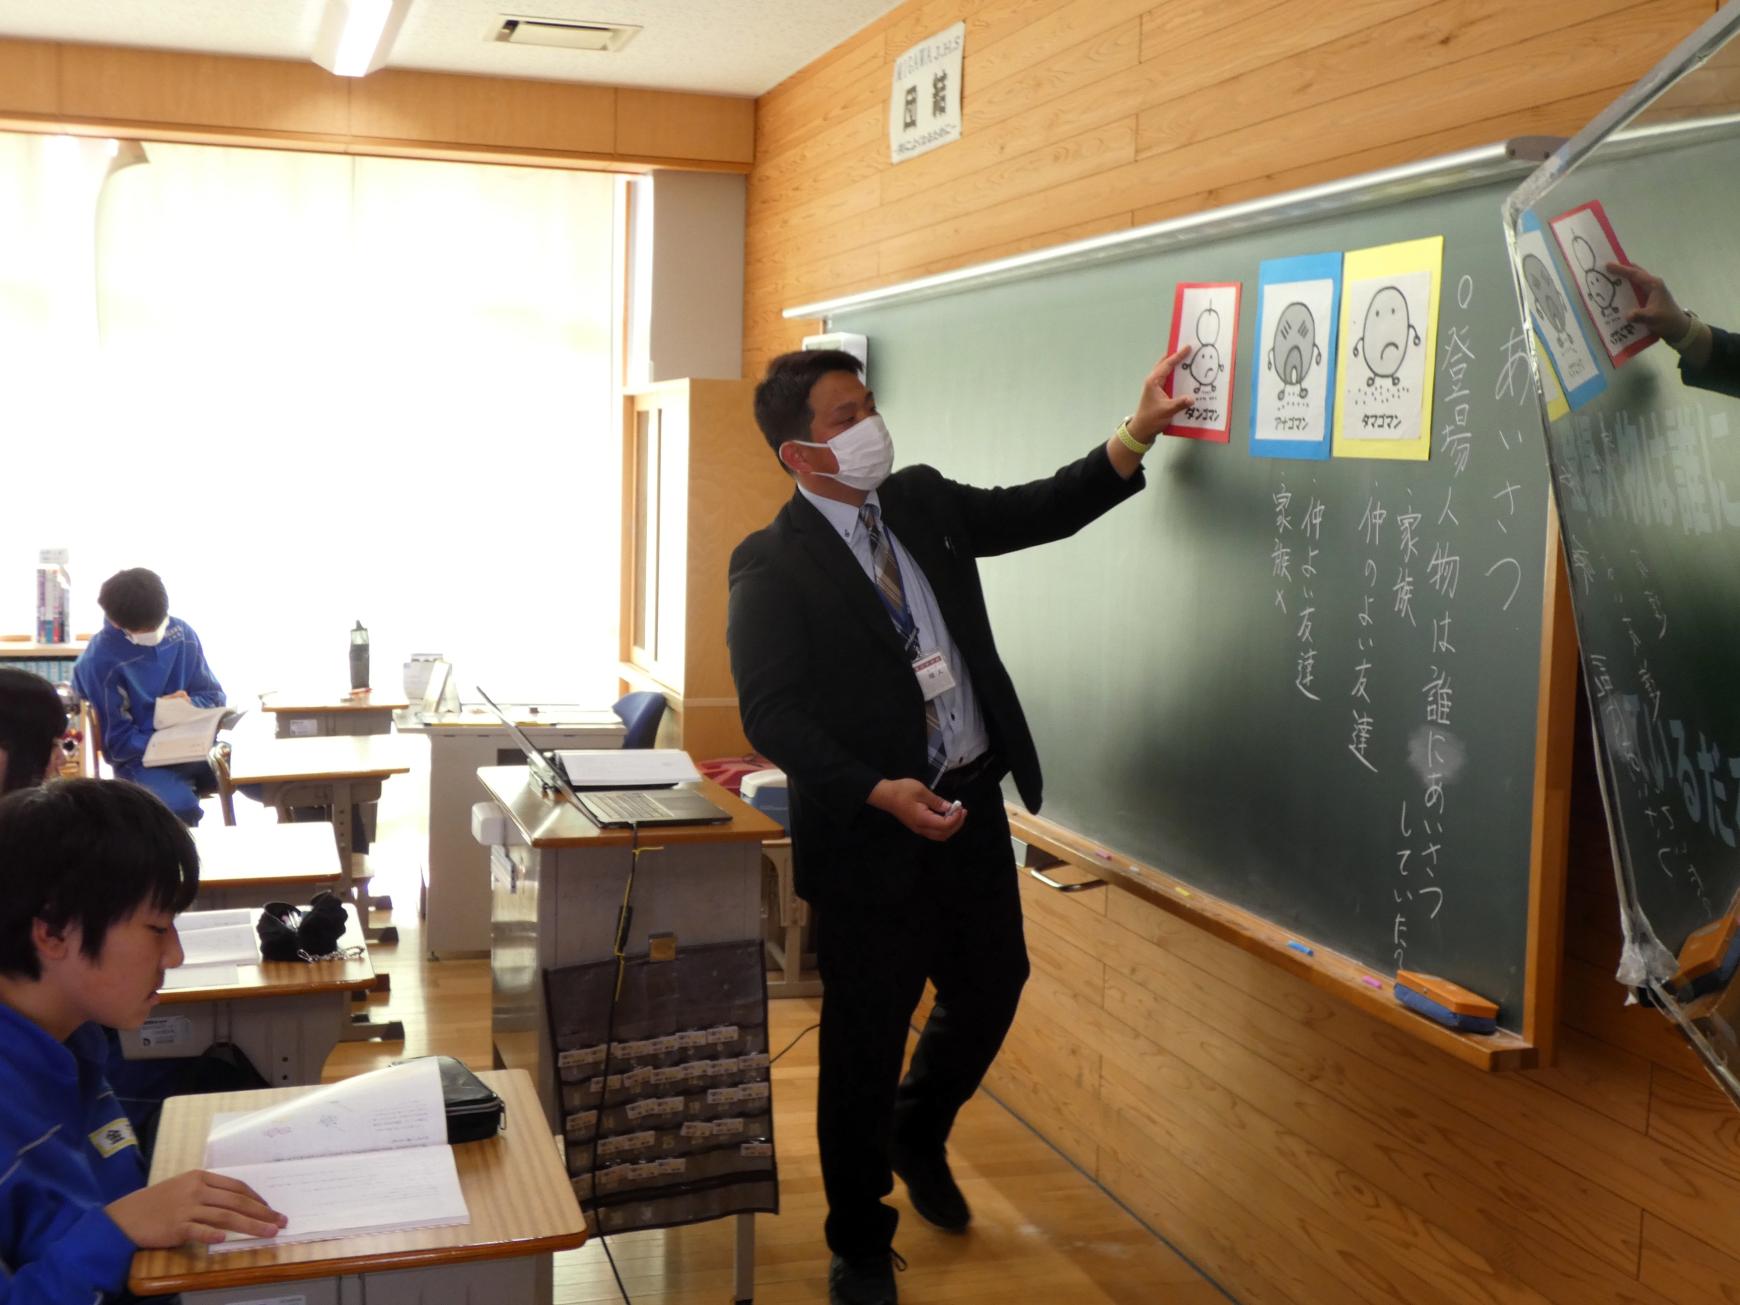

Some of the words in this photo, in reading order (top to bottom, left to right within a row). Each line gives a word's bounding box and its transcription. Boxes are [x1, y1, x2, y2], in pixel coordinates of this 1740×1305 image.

[1184, 406, 1220, 422] ダンゴマン
[1361, 413, 1402, 430] タマゴマン
[1273, 415, 1309, 431] アナゴマン
[1485, 326, 1530, 611] あいさつ
